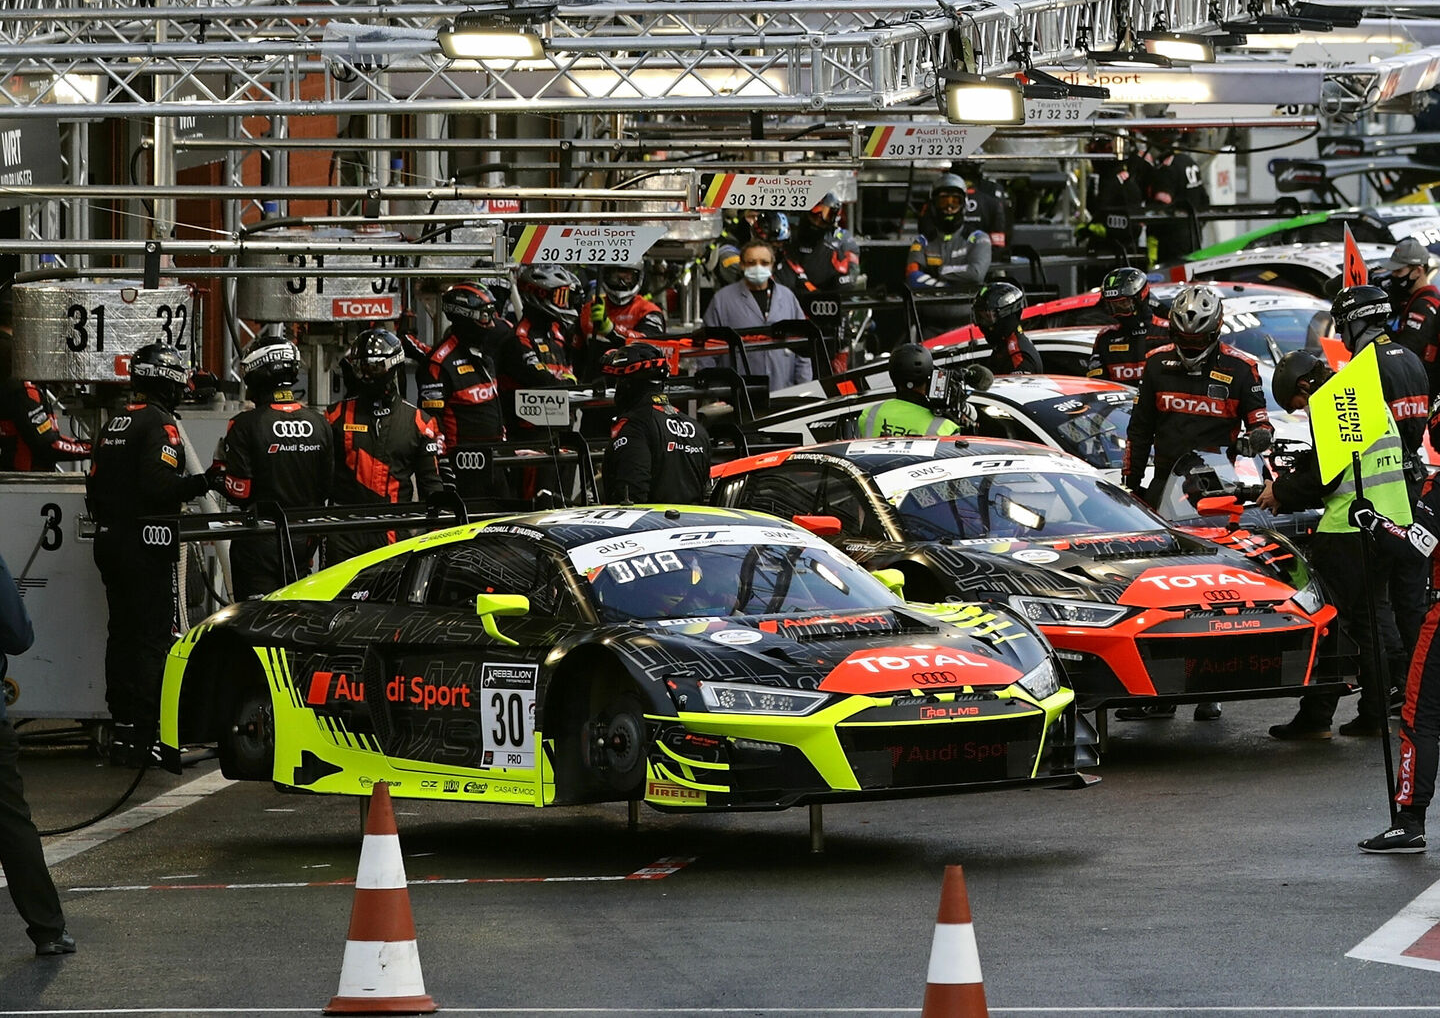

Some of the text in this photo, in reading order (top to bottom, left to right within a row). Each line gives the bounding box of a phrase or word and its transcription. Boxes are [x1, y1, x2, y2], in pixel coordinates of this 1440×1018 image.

[1037, 101, 1083, 109] Team WRT
[1028, 109, 1080, 120] 31 32 33
[916, 128, 968, 137] Audi Sport
[916, 136, 966, 144] Team WRT
[1, 129, 22, 167] WRT
[889, 144, 963, 156] 30 31 32 33
[758, 177, 812, 187] Audi Sport
[758, 186, 811, 195] Team WRT
[729, 194, 807, 208] 30 31 32 33
[574, 228, 636, 238] Audi Sport
[574, 238, 634, 247] Team WRT
[541, 248, 630, 262] 30 31 32 33
[338, 301, 390, 316] TOTAL
[66, 304, 188, 353] 31 32
[601, 358, 666, 375] SCOTT
[1112, 365, 1144, 378] TOT
[1053, 399, 1084, 412] aws
[1162, 395, 1223, 415] TOTAL
[1334, 393, 1352, 442] START
[1344, 387, 1363, 443] ENGINE
[279, 443, 321, 454] Audi Sport
[1376, 455, 1392, 468] PIT
[910, 465, 946, 479] aws
[570, 510, 627, 521] 30
[40, 502, 63, 552] 3
[761, 531, 800, 541] aws
[598, 539, 638, 555] aws
[1140, 573, 1266, 591] TOTAL
[1234, 620, 1261, 629] LMS
[847, 654, 989, 673] TOTAL
[492, 669, 532, 679] REBELLION
[410, 676, 471, 710] Sport
[949, 707, 980, 716] LMS
[491, 692, 524, 747] 30
[507, 753, 522, 765] PRO
[907, 743, 958, 763] Audi
[1397, 747, 1412, 802] TOTAL
[420, 780, 438, 788] OZ
[493, 785, 512, 794] CASA
[648, 782, 700, 799] PIRELLI
